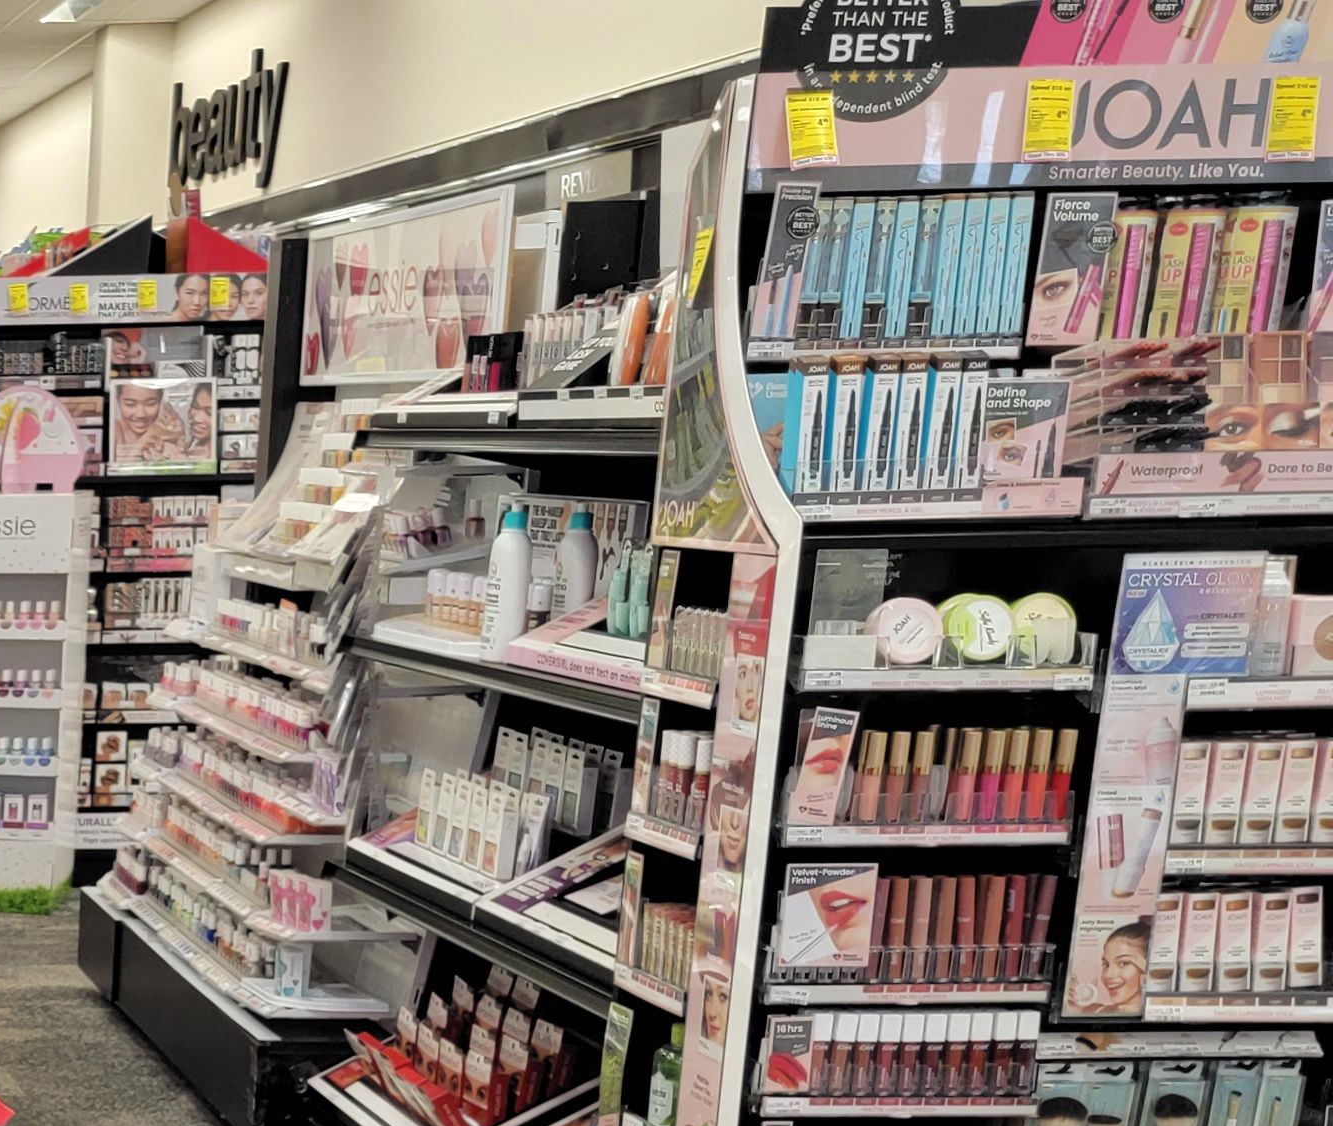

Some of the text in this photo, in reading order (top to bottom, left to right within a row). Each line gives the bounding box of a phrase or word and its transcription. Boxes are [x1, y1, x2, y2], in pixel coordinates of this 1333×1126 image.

[833, 11, 929, 26] THAN THE
[942, 0, 956, 35] oduct
[833, 96, 892, 114] dependent
[894, 85, 924, 106] blind
[168, 48, 290, 188] beauty
[1072, 78, 1271, 150] JOAH
[1049, 163, 1264, 181] Smarter Beauty. Like You.
[1055, 200, 1091, 211] Fierce
[1053, 211, 1099, 222] Volume
[1093, 236, 1113, 244] BEST
[1161, 268, 1182, 282] UP
[1232, 266, 1252, 279] UP
[368, 261, 419, 314] essie
[808, 365, 827, 374] JOAH
[842, 364, 860, 373] JOAH
[879, 364, 898, 372] JOAH
[907, 363, 925, 371] JOAH
[941, 362, 960, 370] JOAH
[968, 361, 986, 370] JOAH
[988, 387, 1027, 399] Define
[986, 398, 1051, 410] and Shape
[1131, 463, 1203, 479] Waterproof
[1268, 463, 1332, 474] Dare to Be
[661, 501, 696, 528] JOAH
[1128, 571, 1255, 588] CRYSTAL GLOW
[893, 614, 911, 635] JOAH
[537, 655, 641, 685] COVERGIRL does not test on anima
[818, 714, 853, 726] Luminous
[792, 868, 855, 878] Velvet-Powder
[791, 876, 817, 885] Finish
[776, 1024, 787, 1033] 16
